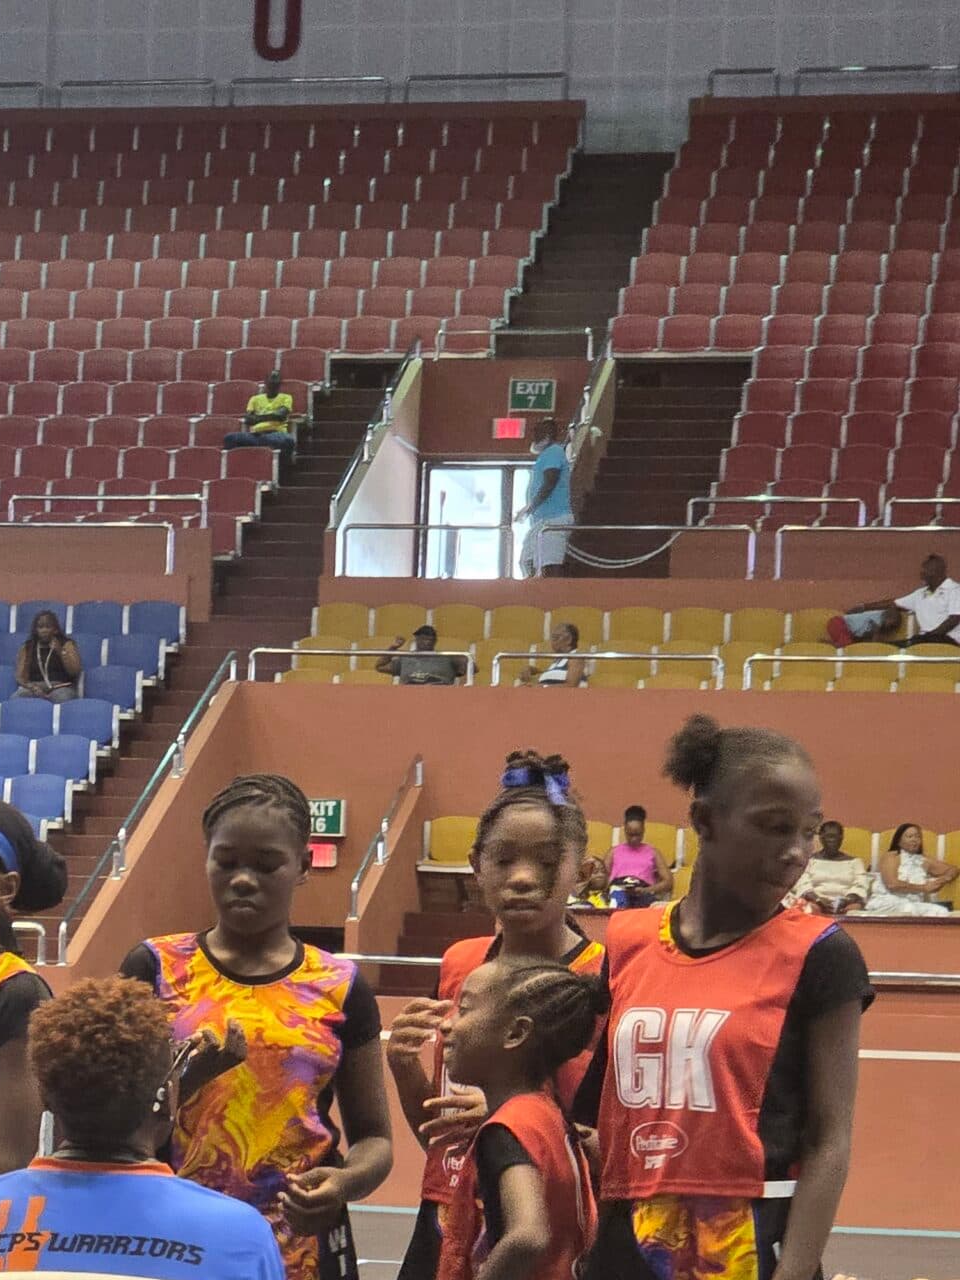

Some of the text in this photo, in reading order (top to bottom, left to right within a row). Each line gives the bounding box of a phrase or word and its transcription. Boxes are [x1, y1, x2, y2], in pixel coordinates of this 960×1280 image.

[515, 382, 549, 395] EXIT
[527, 396, 537, 408] 7
[308, 801, 337, 816] XIT
[614, 1007, 731, 1112] GK
[47, 1231, 205, 1266] WARRIORS
